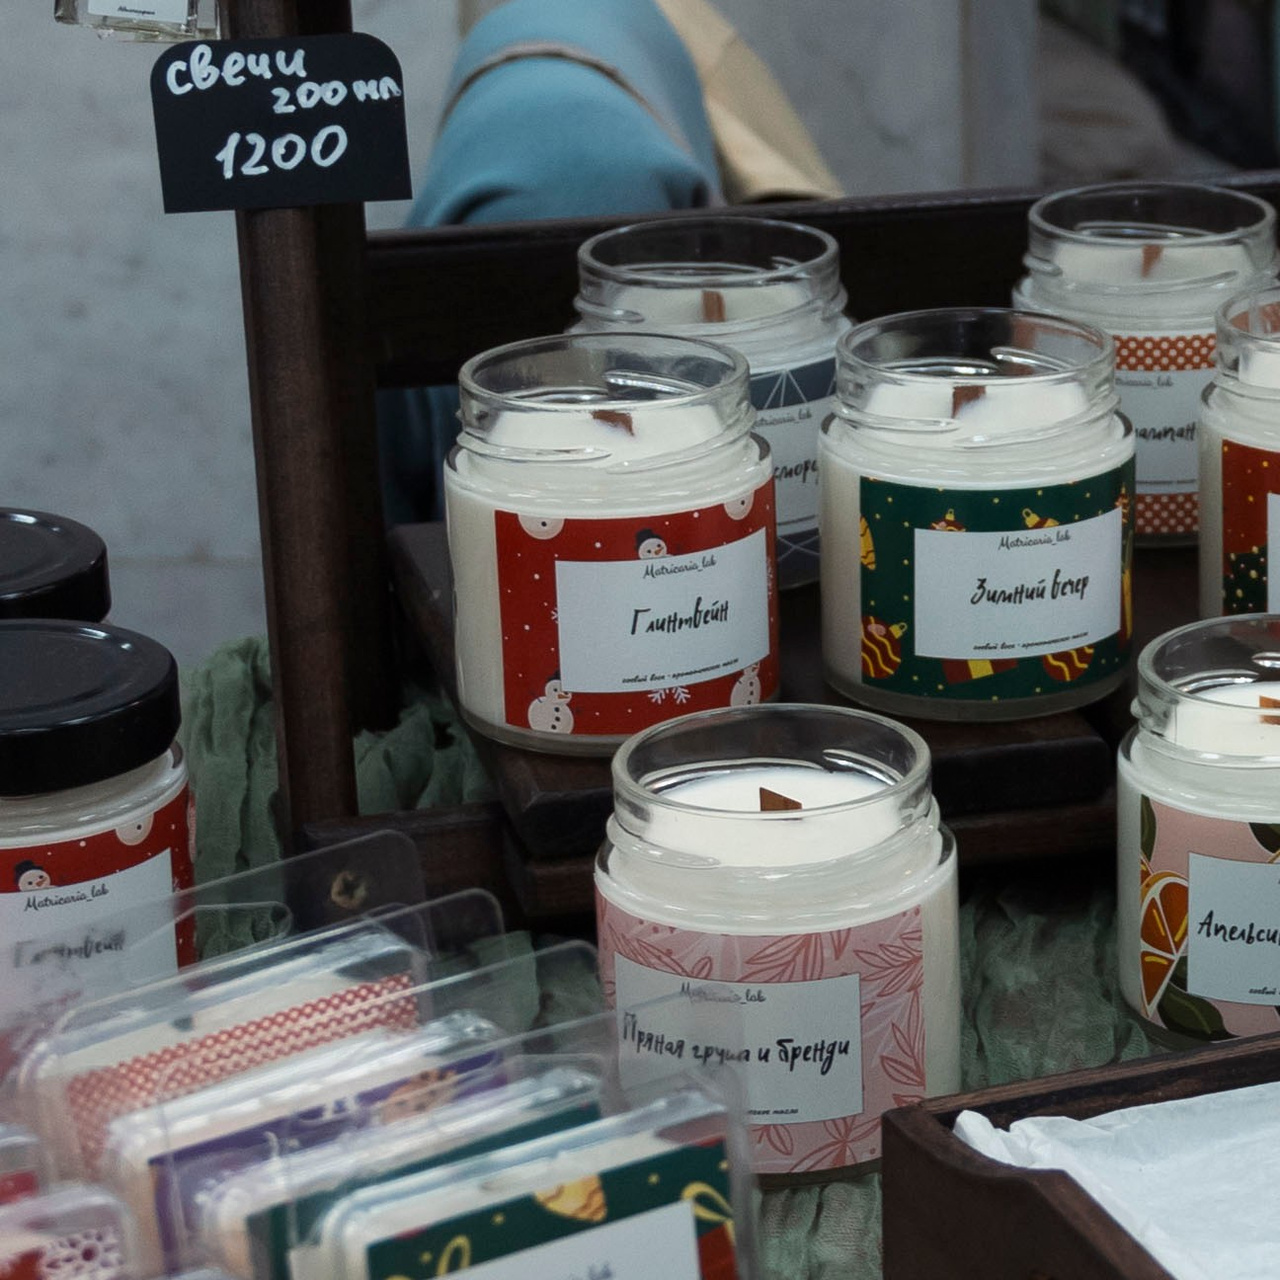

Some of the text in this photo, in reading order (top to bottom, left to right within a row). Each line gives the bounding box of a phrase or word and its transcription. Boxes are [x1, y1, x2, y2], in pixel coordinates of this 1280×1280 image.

[165, 44, 308, 96] свечи
[215, 124, 349, 180] 1200
[997, 529, 1072, 551] Matricaria_lab
[642, 554, 718, 580] Matricaria_lab
[970, 568, 1090, 606] Зимний вечер
[630, 596, 730, 636] Глинтвейн
[23, 882, 109, 913] Matricaria_lab
[622, 1010, 686, 1060] Пряная
[757, 1045, 771, 1064] и
[775, 1037, 851, 1077] бренди
